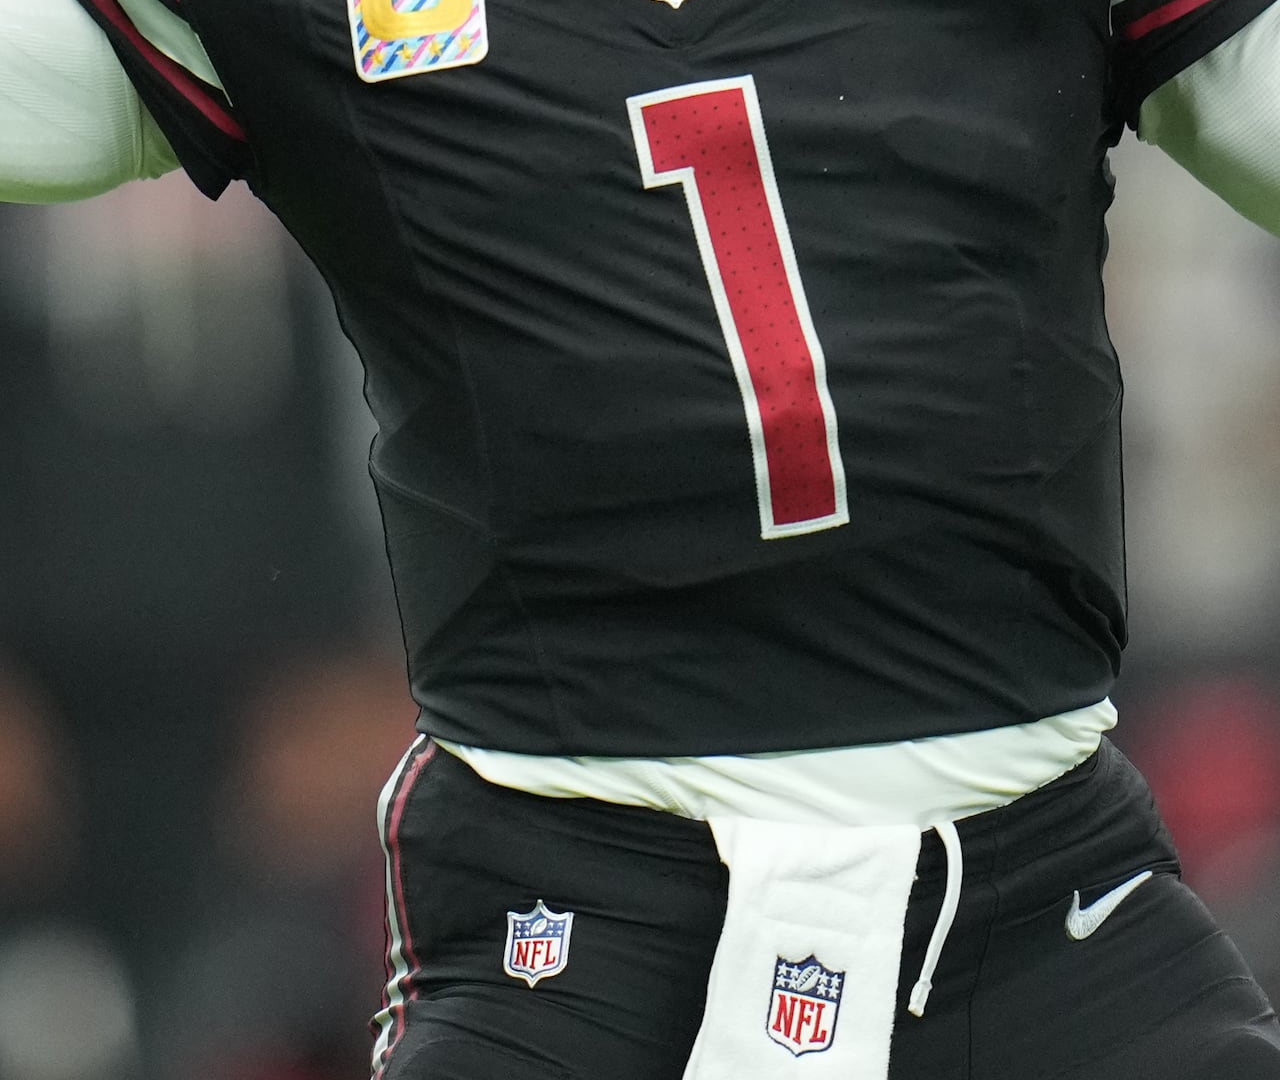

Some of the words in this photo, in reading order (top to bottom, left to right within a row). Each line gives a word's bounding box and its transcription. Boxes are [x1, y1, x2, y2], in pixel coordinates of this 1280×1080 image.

[626, 74, 850, 540] 1
[513, 940, 556, 970] NFL
[772, 994, 827, 1046] NFL
